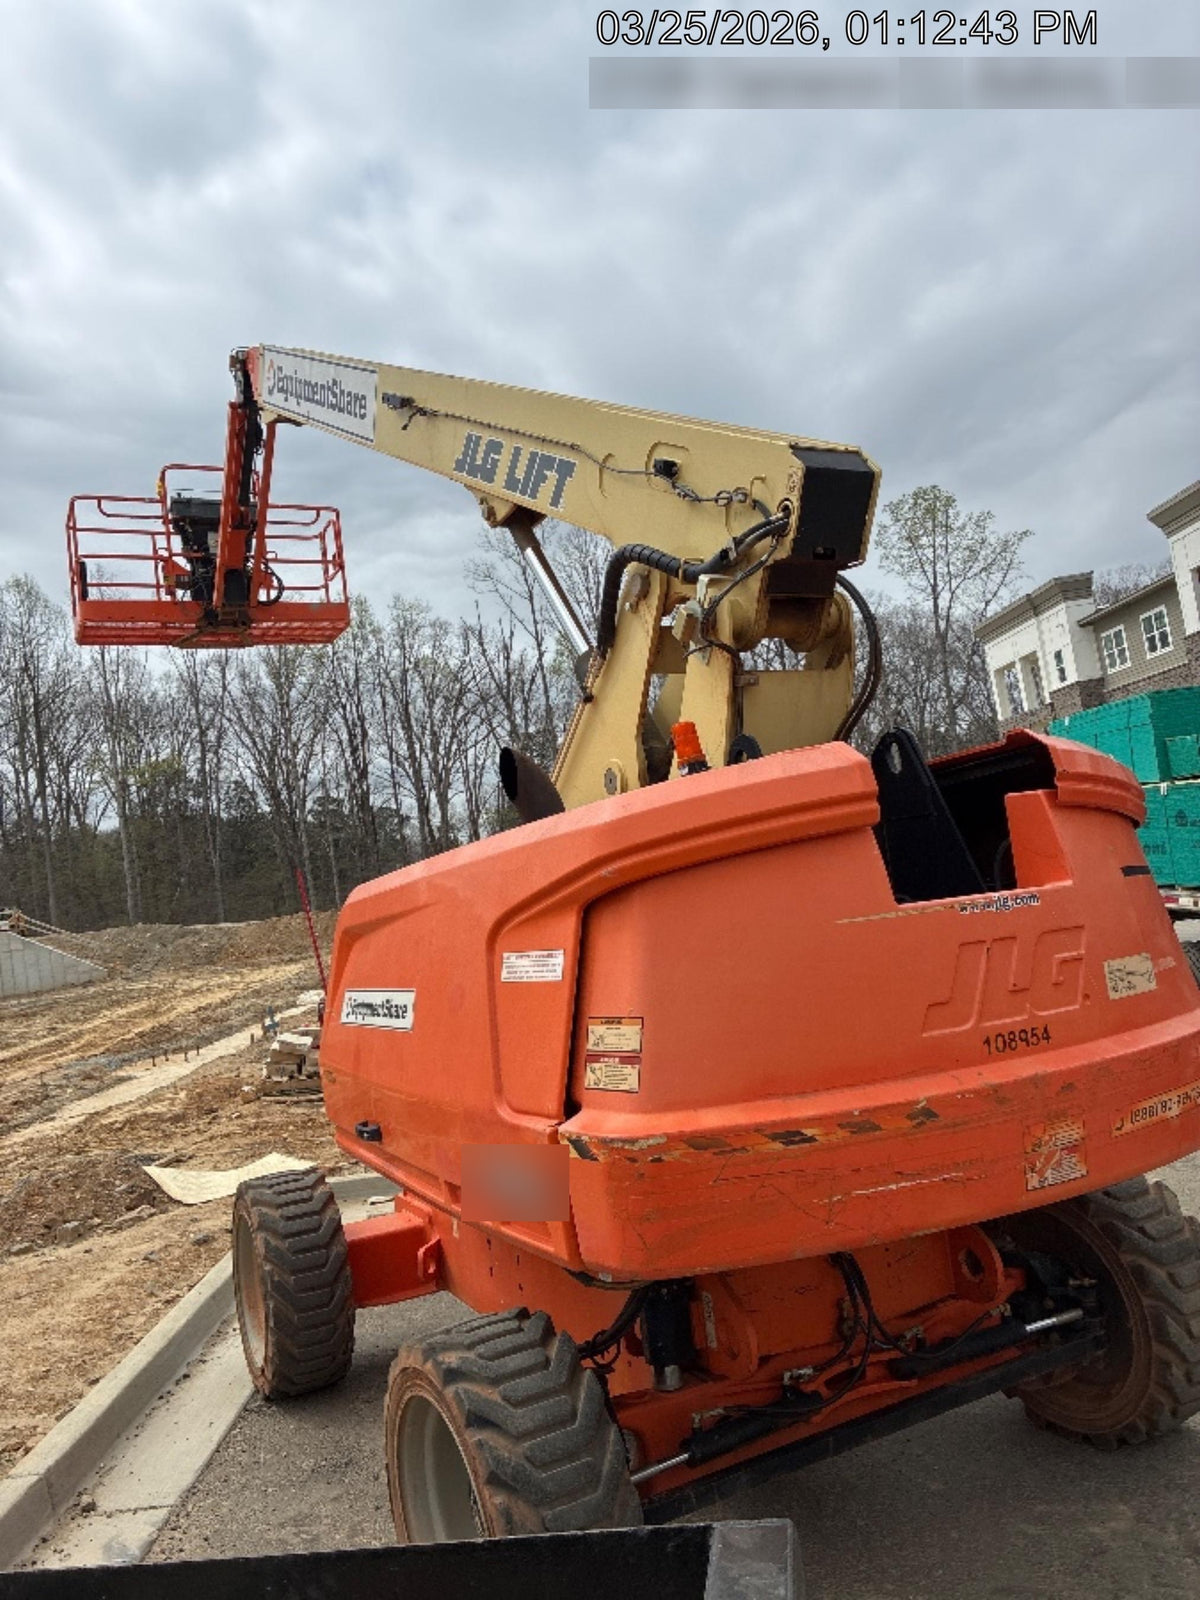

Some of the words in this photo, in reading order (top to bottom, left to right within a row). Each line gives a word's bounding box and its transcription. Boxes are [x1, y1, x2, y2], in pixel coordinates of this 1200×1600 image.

[276, 365, 367, 420] EquipmentShare
[453, 430, 505, 485] JLG
[502, 444, 578, 512] LIFT
[921, 924, 1086, 1037] JLG
[982, 1023, 1052, 1056] 108954
